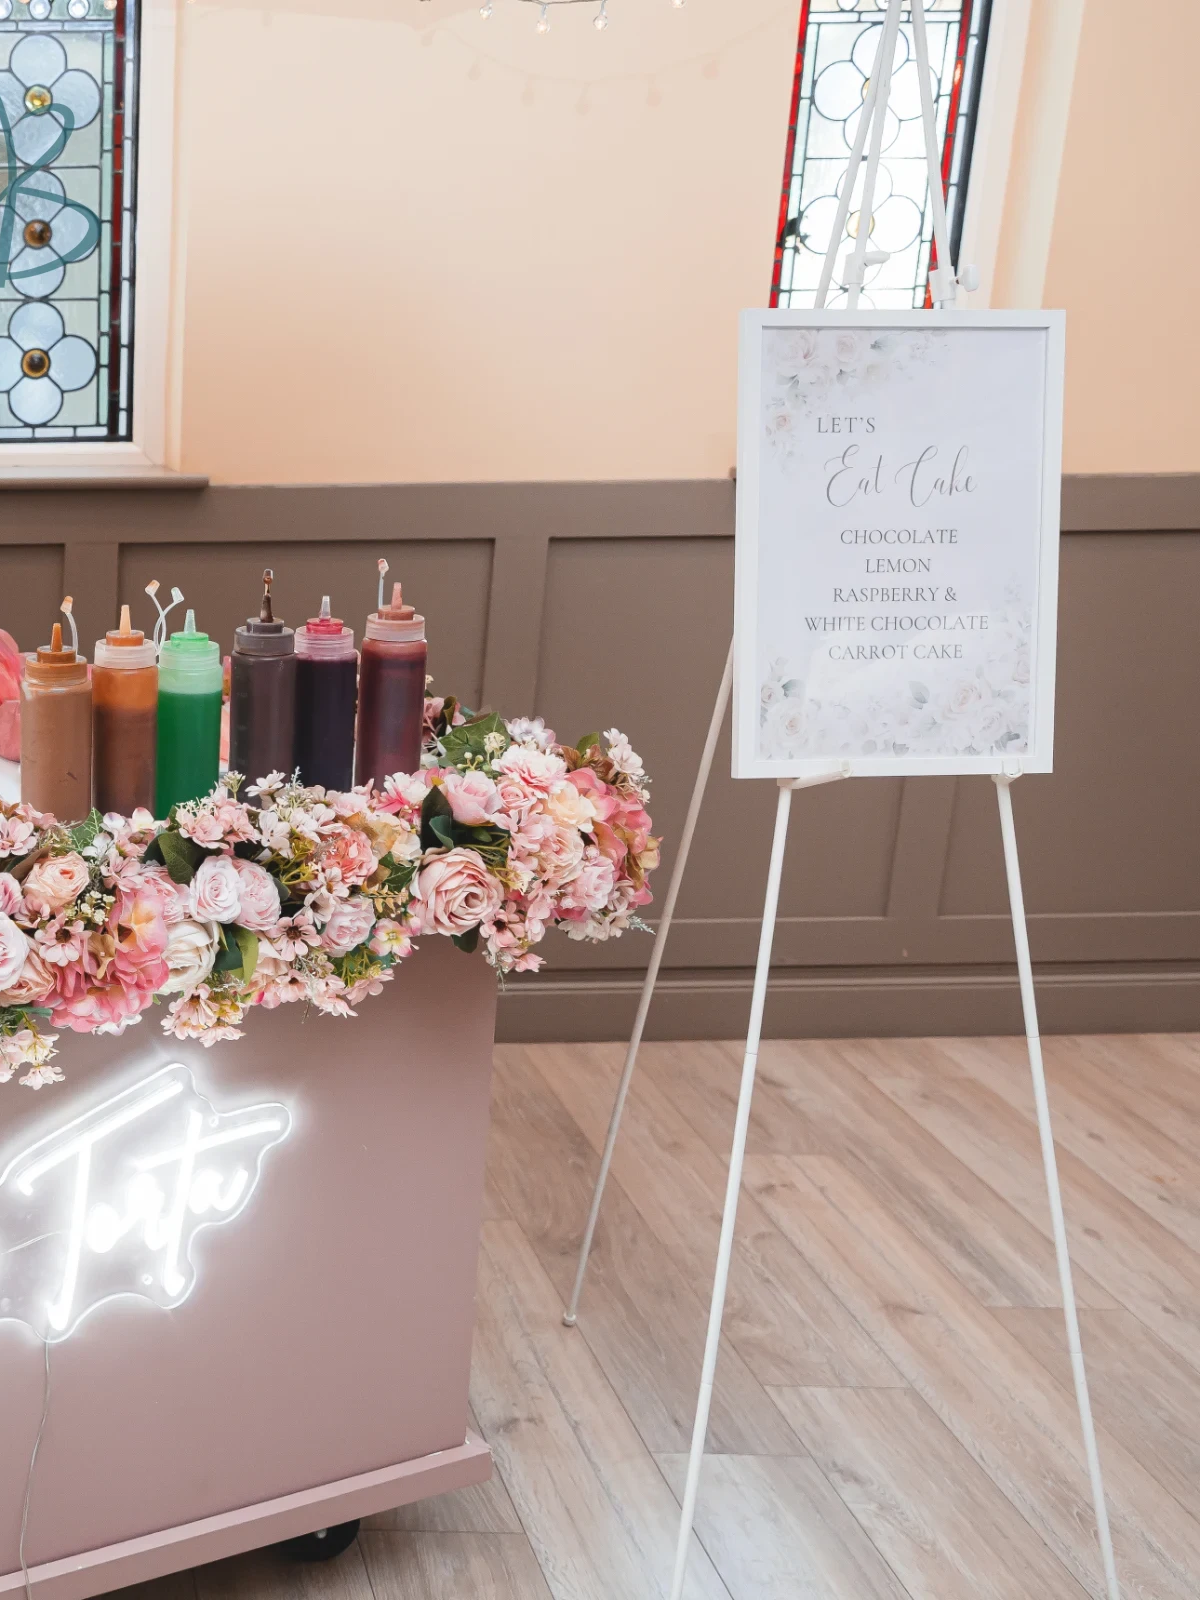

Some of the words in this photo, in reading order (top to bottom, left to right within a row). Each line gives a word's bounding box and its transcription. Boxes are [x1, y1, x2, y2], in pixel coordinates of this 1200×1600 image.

[824, 444, 886, 507] Eat
[894, 444, 977, 507] Cake
[840, 528, 959, 545] CHOCOLATE
[865, 558, 932, 574] LEMON
[832, 586, 940, 603] RASPBERRY
[944, 586, 958, 602] &
[804, 616, 866, 632] WHITE
[870, 615, 989, 631] CHOCOLATE
[828, 644, 909, 660] CARROT
[913, 644, 964, 660] CAKE
[15, 1079, 282, 1331] Torta
